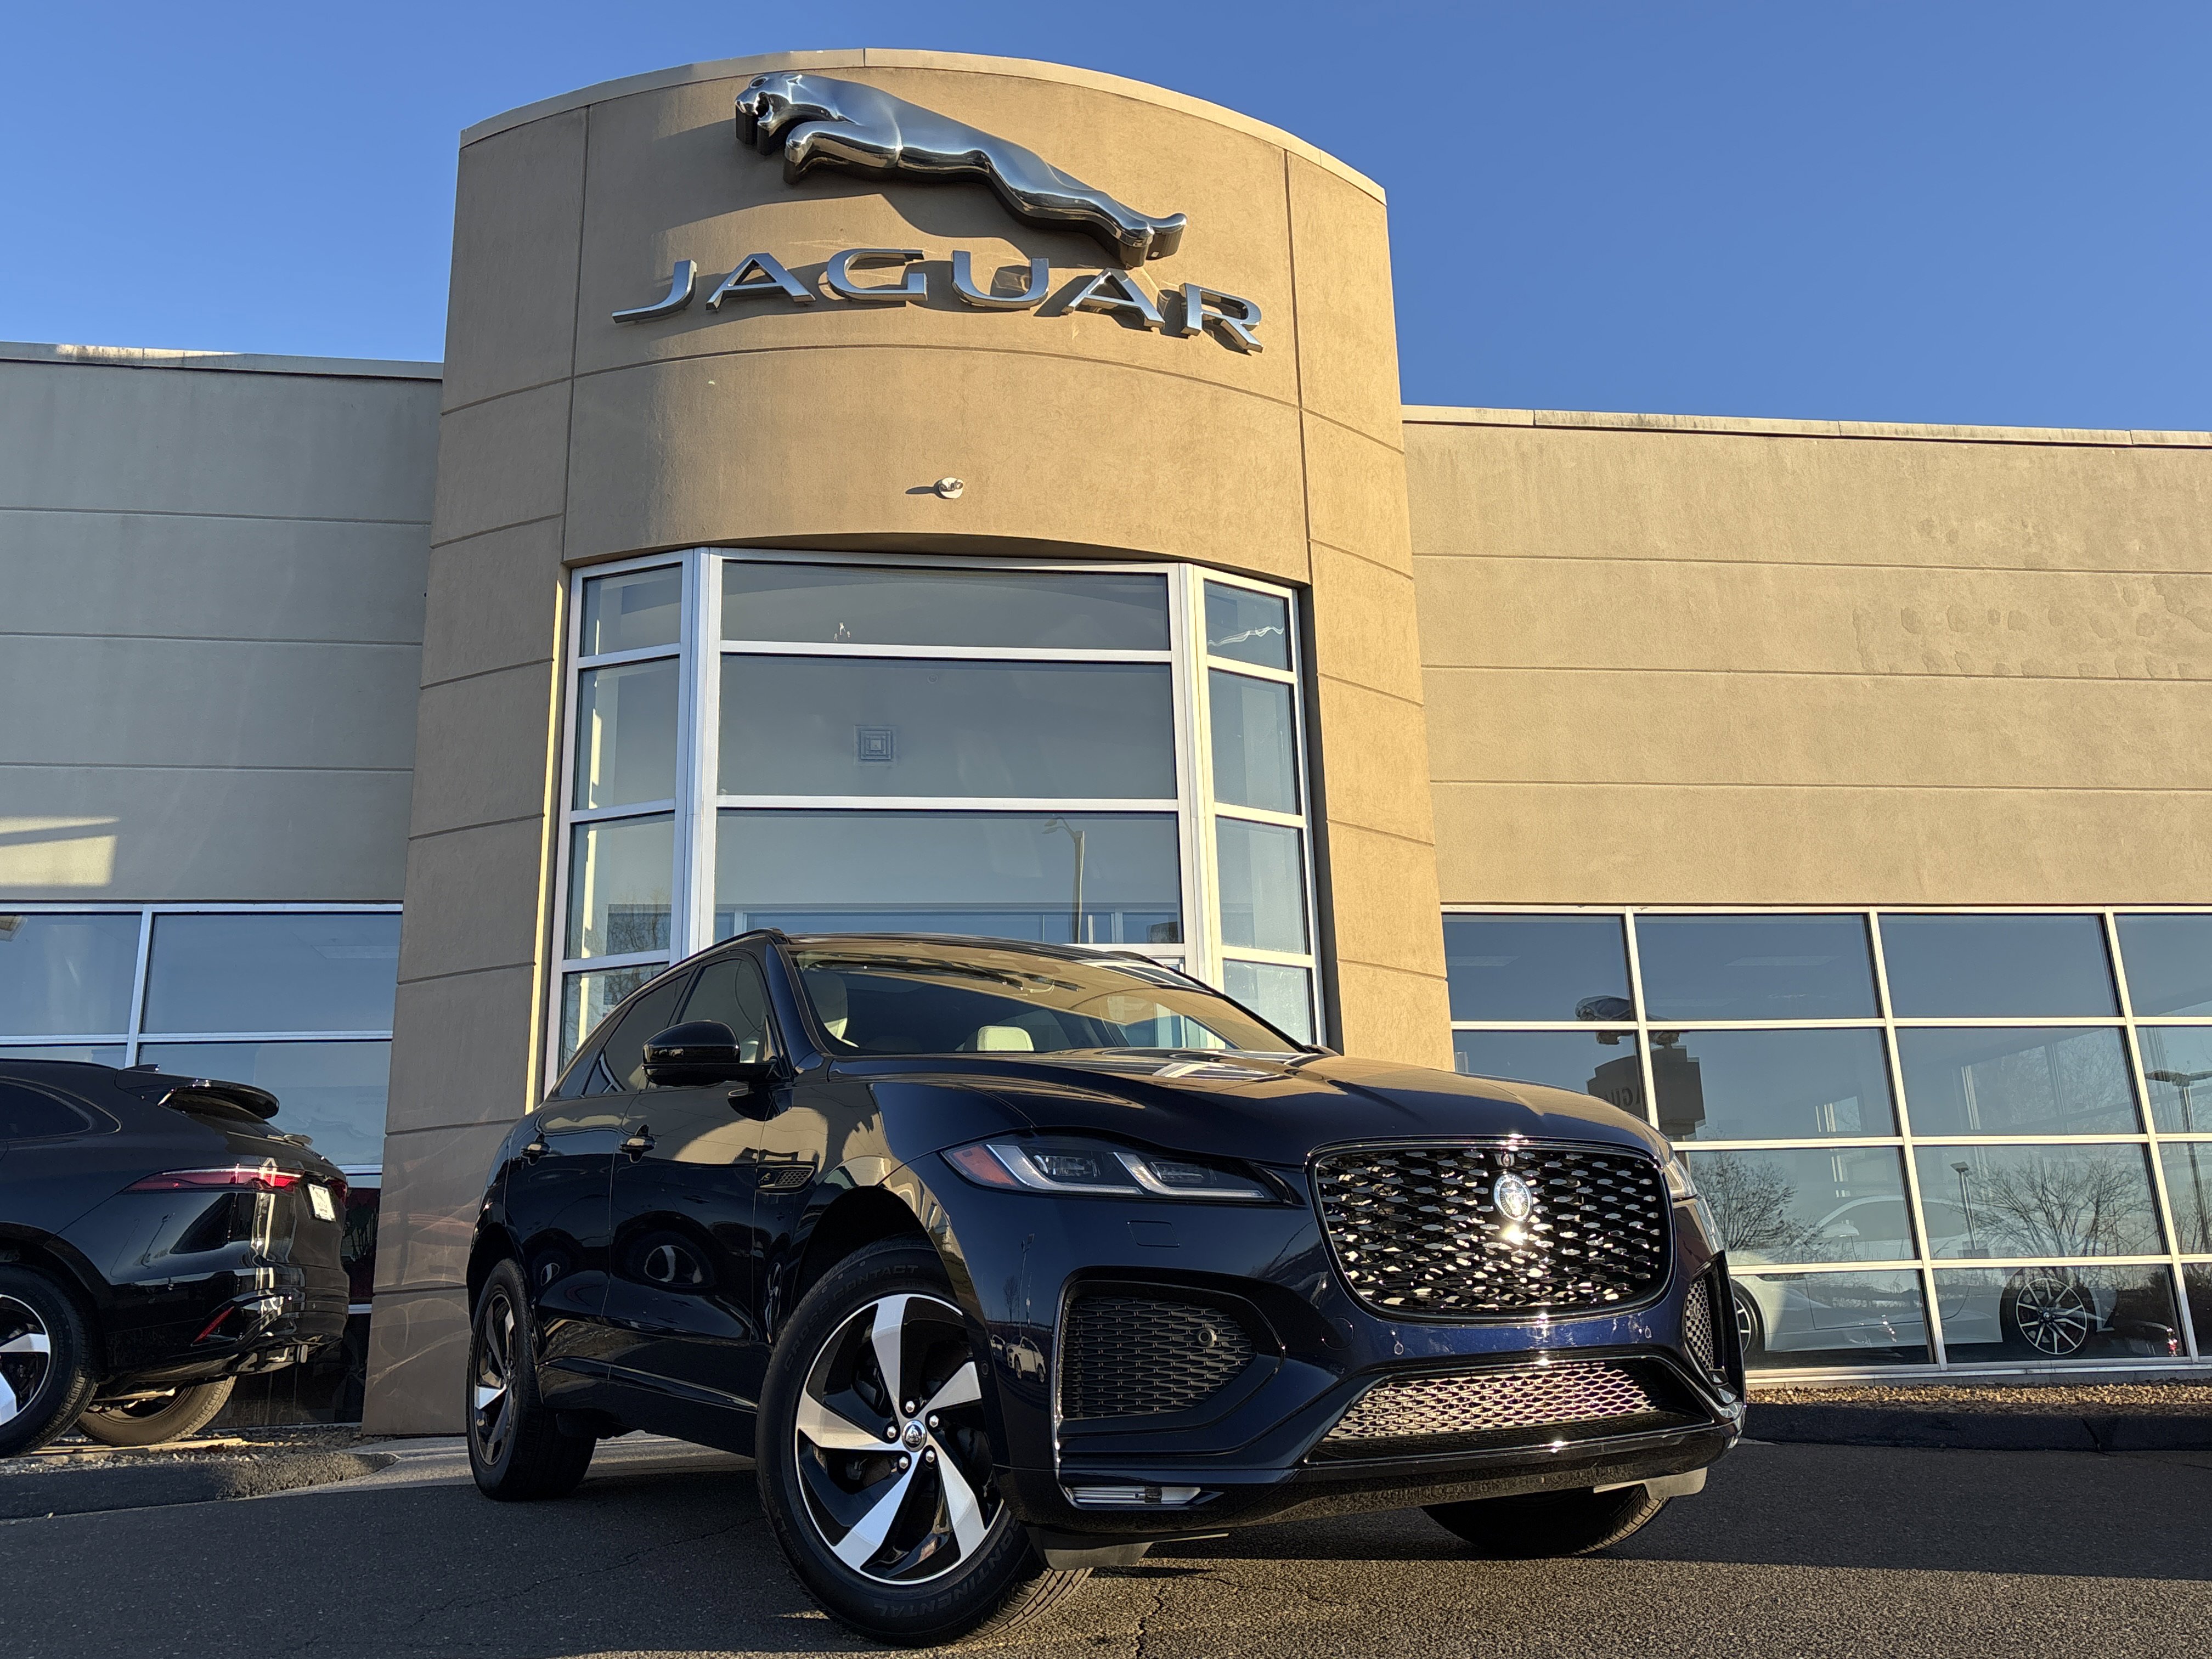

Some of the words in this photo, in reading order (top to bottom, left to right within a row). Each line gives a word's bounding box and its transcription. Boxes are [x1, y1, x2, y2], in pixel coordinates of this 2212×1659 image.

[611, 248, 1263, 355] JAGUAR
[784, 1300, 830, 1371] CROSS
[833, 1265, 919, 1301] CONTACT
